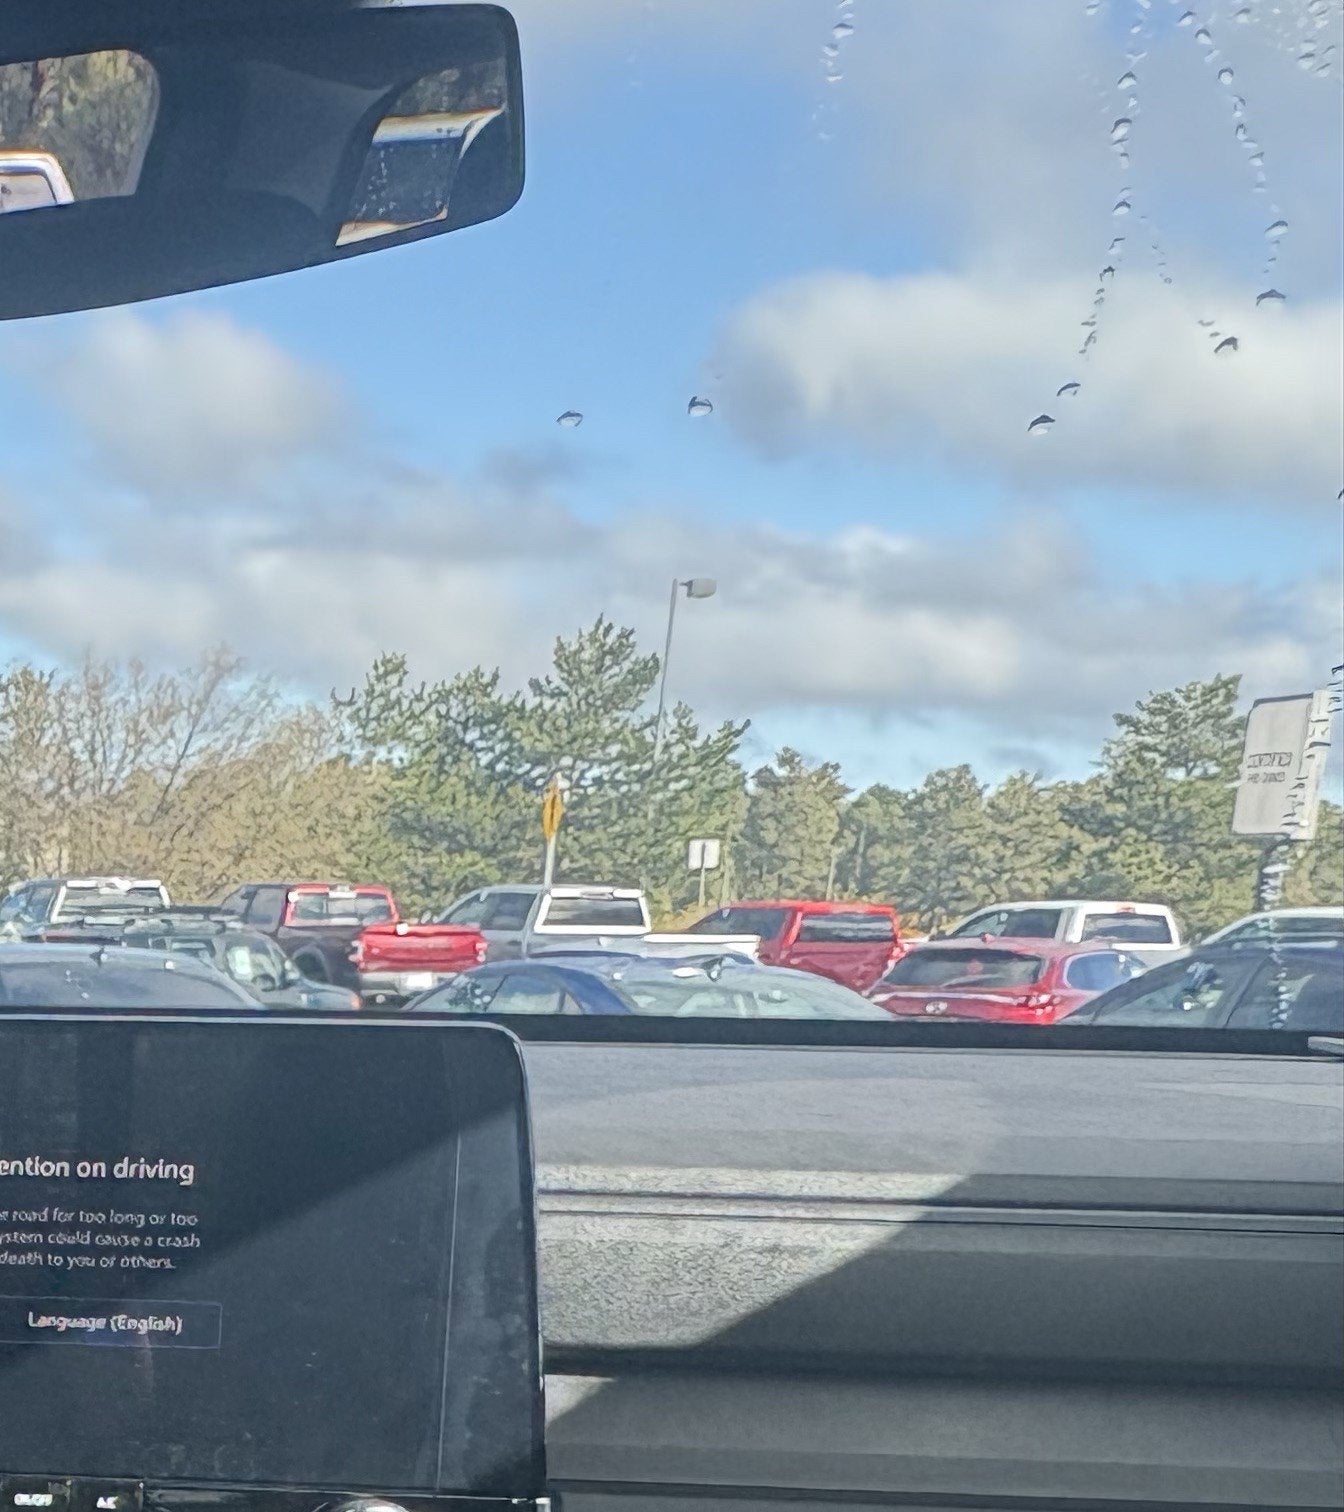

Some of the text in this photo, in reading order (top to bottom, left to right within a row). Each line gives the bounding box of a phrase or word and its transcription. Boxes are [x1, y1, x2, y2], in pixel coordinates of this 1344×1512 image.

[76, 1161, 106, 1178] on
[113, 1156, 194, 1186] driving
[12, 1206, 49, 1222] road
[53, 1207, 75, 1222] for
[79, 1209, 106, 1223] too
[109, 1209, 145, 1228] long
[149, 1213, 166, 1224] or
[171, 1212, 198, 1226] too
[47, 1230, 91, 1245] could
[95, 1233, 140, 1246] cause
[143, 1235, 153, 1247] a
[157, 1232, 201, 1248] crash
[47, 1252, 63, 1266] to
[66, 1255, 95, 1270] you
[99, 1256, 116, 1268] or
[28, 1311, 183, 1334] Language (English)
